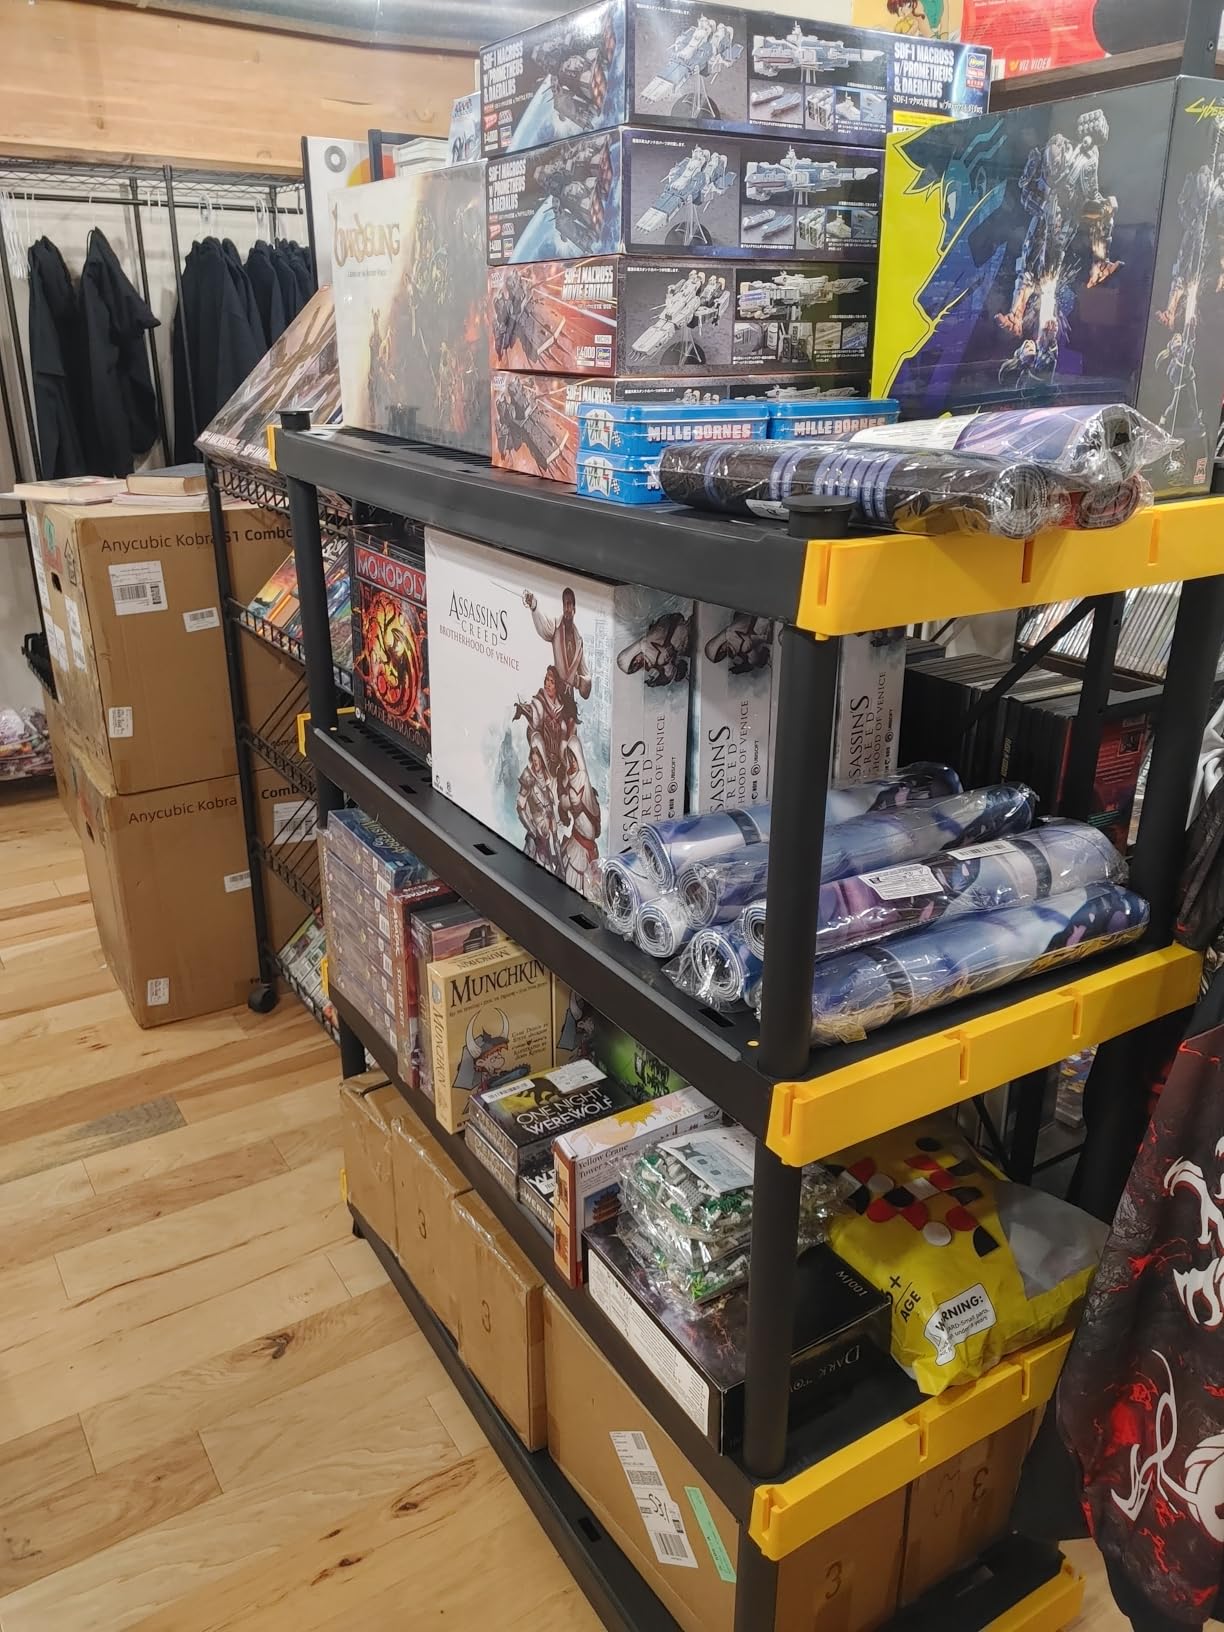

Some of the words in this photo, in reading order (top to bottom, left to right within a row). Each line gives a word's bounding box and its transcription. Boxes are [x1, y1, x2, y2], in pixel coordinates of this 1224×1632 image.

[894, 42, 916, 60] SDF-1
[916, 44, 955, 66] MACROSS
[894, 60, 954, 82] w/PROMETHEUS
[894, 77, 902, 93] &
[902, 78, 943, 98] DAEDALUS
[582, 265, 614, 283] MACROSS
[562, 284, 585, 301] MOVIE
[585, 283, 613, 300] EDITION
[582, 385, 612, 403] MACROSS
[647, 425, 691, 442] MILLE
[693, 423, 751, 441] BORNES
[793, 420, 833, 436] MILLE
[834, 417, 886, 434] BORNES
[101, 535, 172, 553] Anycubic
[176, 532, 215, 549] Kobra
[357, 556, 427, 601] MONOPOLY
[449, 588, 508, 642] ASSASSIN'S
[440, 624, 486, 658] BROTHERHOOD
[486, 646, 495, 659] OF
[495, 651, 520, 672] VENICE
[460, 622, 499, 647] CREED
[655, 714, 666, 761] VENICE
[740, 700, 750, 745] VENICE
[656, 762, 665, 780] OF
[726, 743, 738, 800] REED
[740, 749, 748, 764] OF
[128, 801, 194, 824] Anycubic
[197, 795, 238, 812] Kobra
[261, 784, 308, 800] Combo
[641, 758, 653, 817] REED
[450, 959, 547, 1008] MUNCHKIN
[432, 1007, 447, 1086] MUNCHKIN
[516, 1103, 555, 1125] ONE
[553, 1086, 604, 1112] NIGHT
[528, 1096, 613, 1136] WEREWOLF
[578, 1153, 604, 1170] Yellow
[605, 1144, 629, 1160] Crane
[579, 1163, 603, 1179] Tower
[900, 1290, 921, 1323] AGE
[935, 1295, 984, 1332] WRNING:
[823, 1559, 843, 1600] 3
